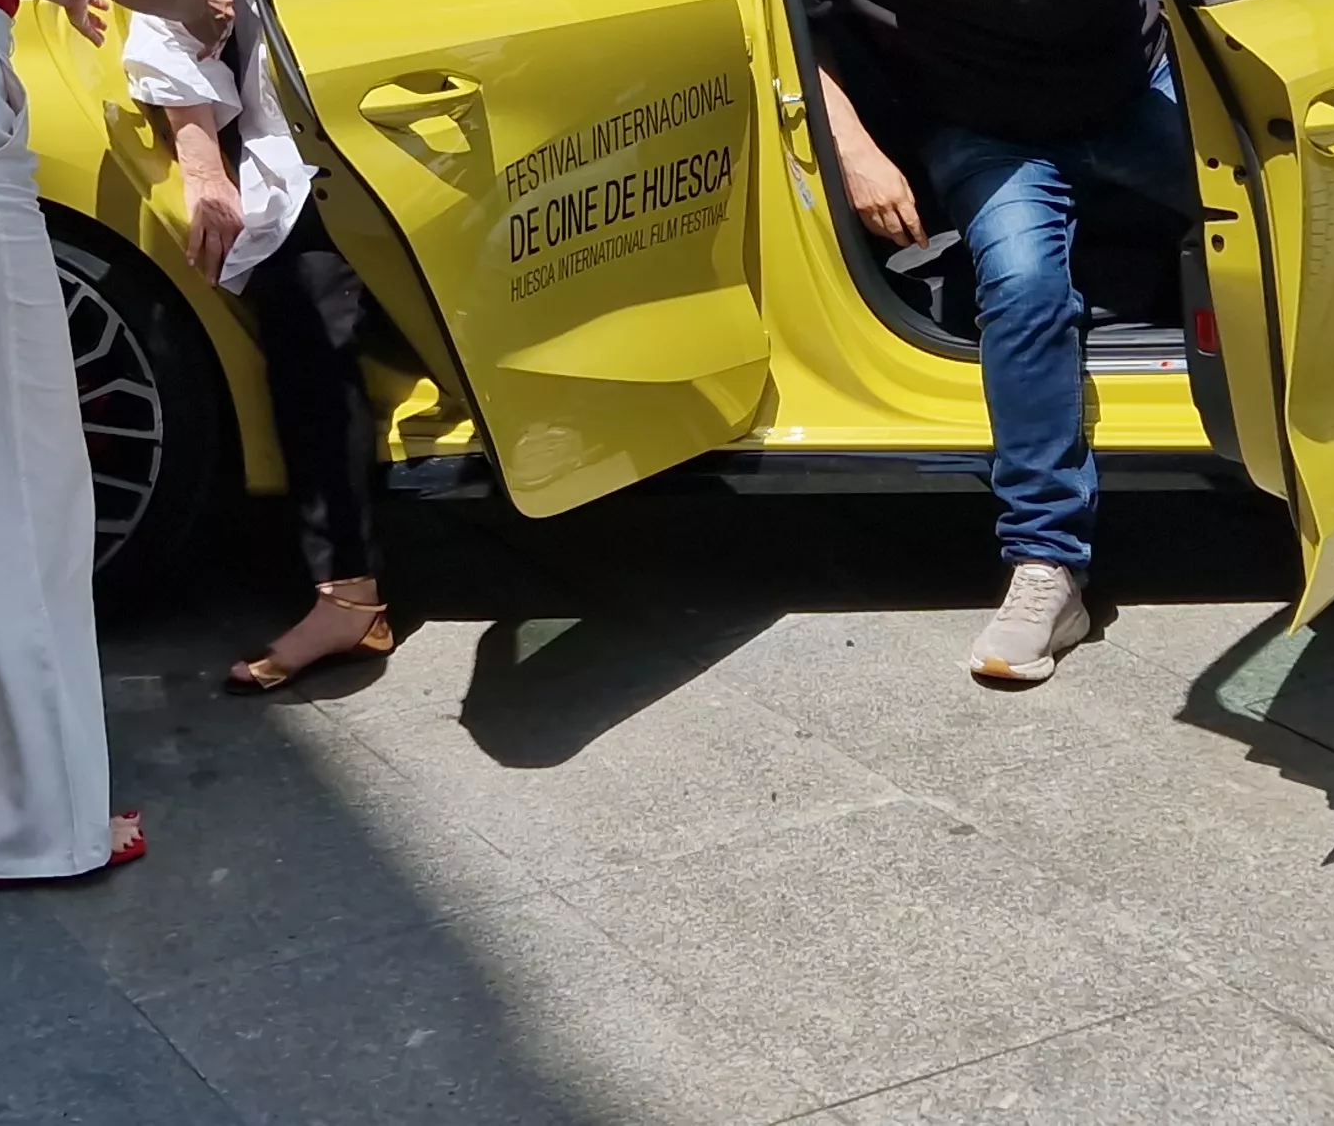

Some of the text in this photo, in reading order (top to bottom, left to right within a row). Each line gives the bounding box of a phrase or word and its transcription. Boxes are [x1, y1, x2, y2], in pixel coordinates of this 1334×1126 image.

[505, 73, 735, 202] FESTIVAL INTERNACIONAL
[510, 146, 733, 263] DE CINE DE HUESCA
[510, 202, 729, 302] HUESCA INTERNATIONAL FILM FESTIVAL
